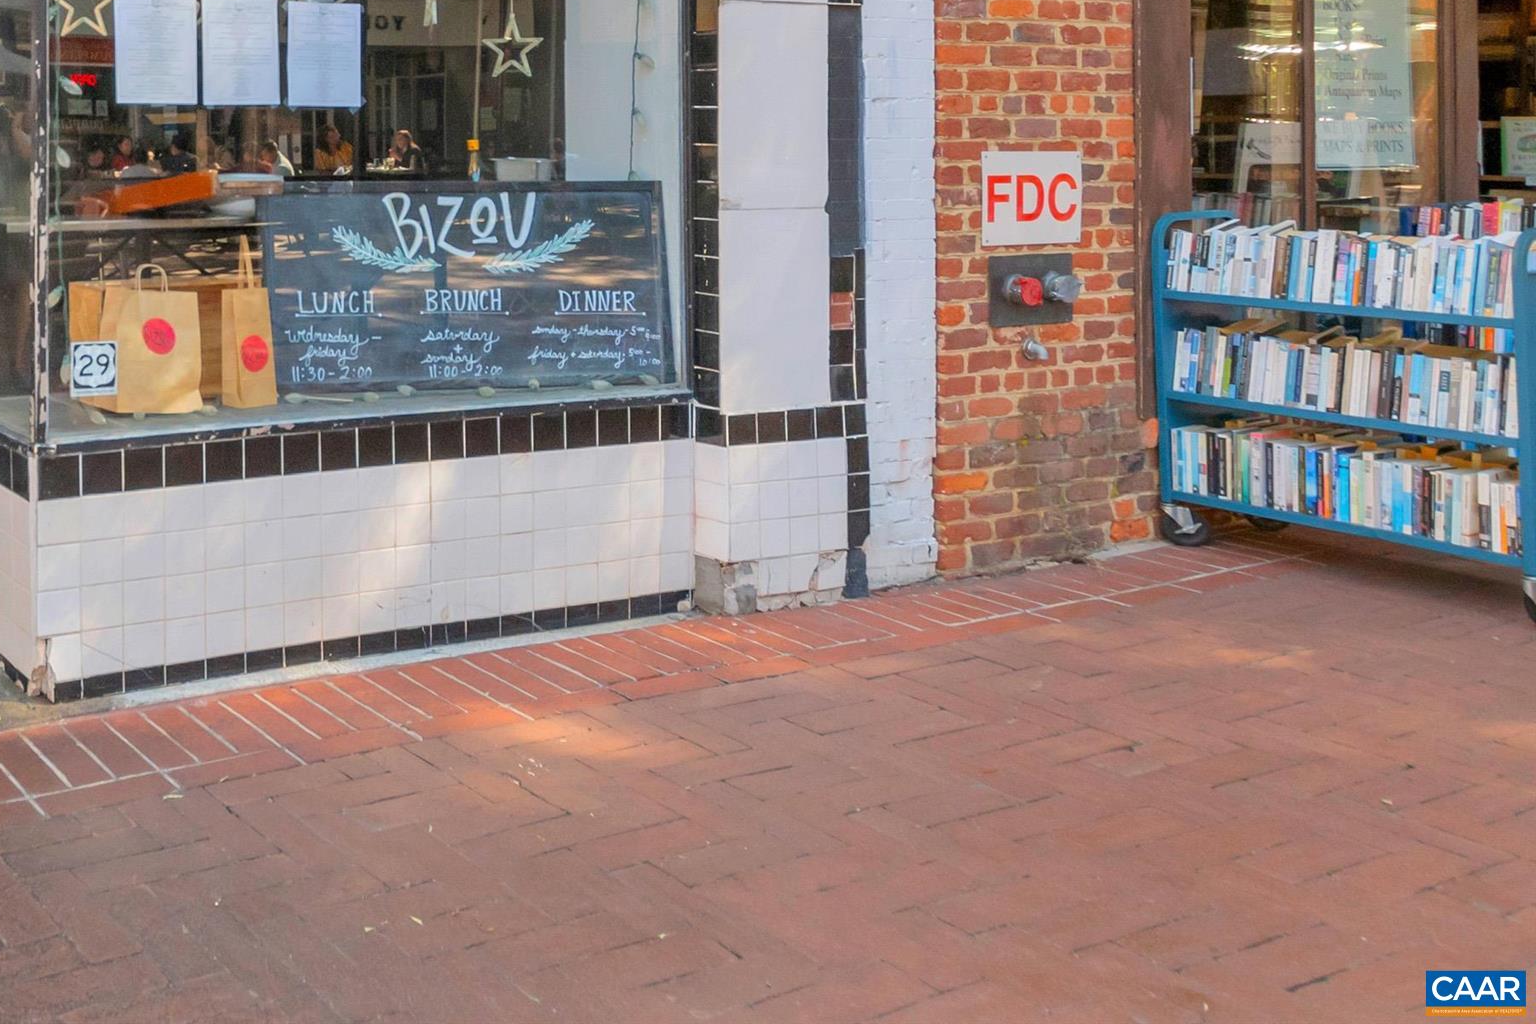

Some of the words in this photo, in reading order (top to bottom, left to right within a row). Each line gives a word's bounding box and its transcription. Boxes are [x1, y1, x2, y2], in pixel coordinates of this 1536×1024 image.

[987, 173, 1077, 223] FDC
[382, 191, 537, 259] BIZOU
[297, 289, 375, 314] LUNCH
[424, 287, 502, 313] BRUNCH
[558, 289, 637, 312] DINNER
[421, 327, 500, 352] saturday
[79, 353, 110, 377] 29
[299, 345, 359, 366] friday
[528, 345, 569, 369] friday
